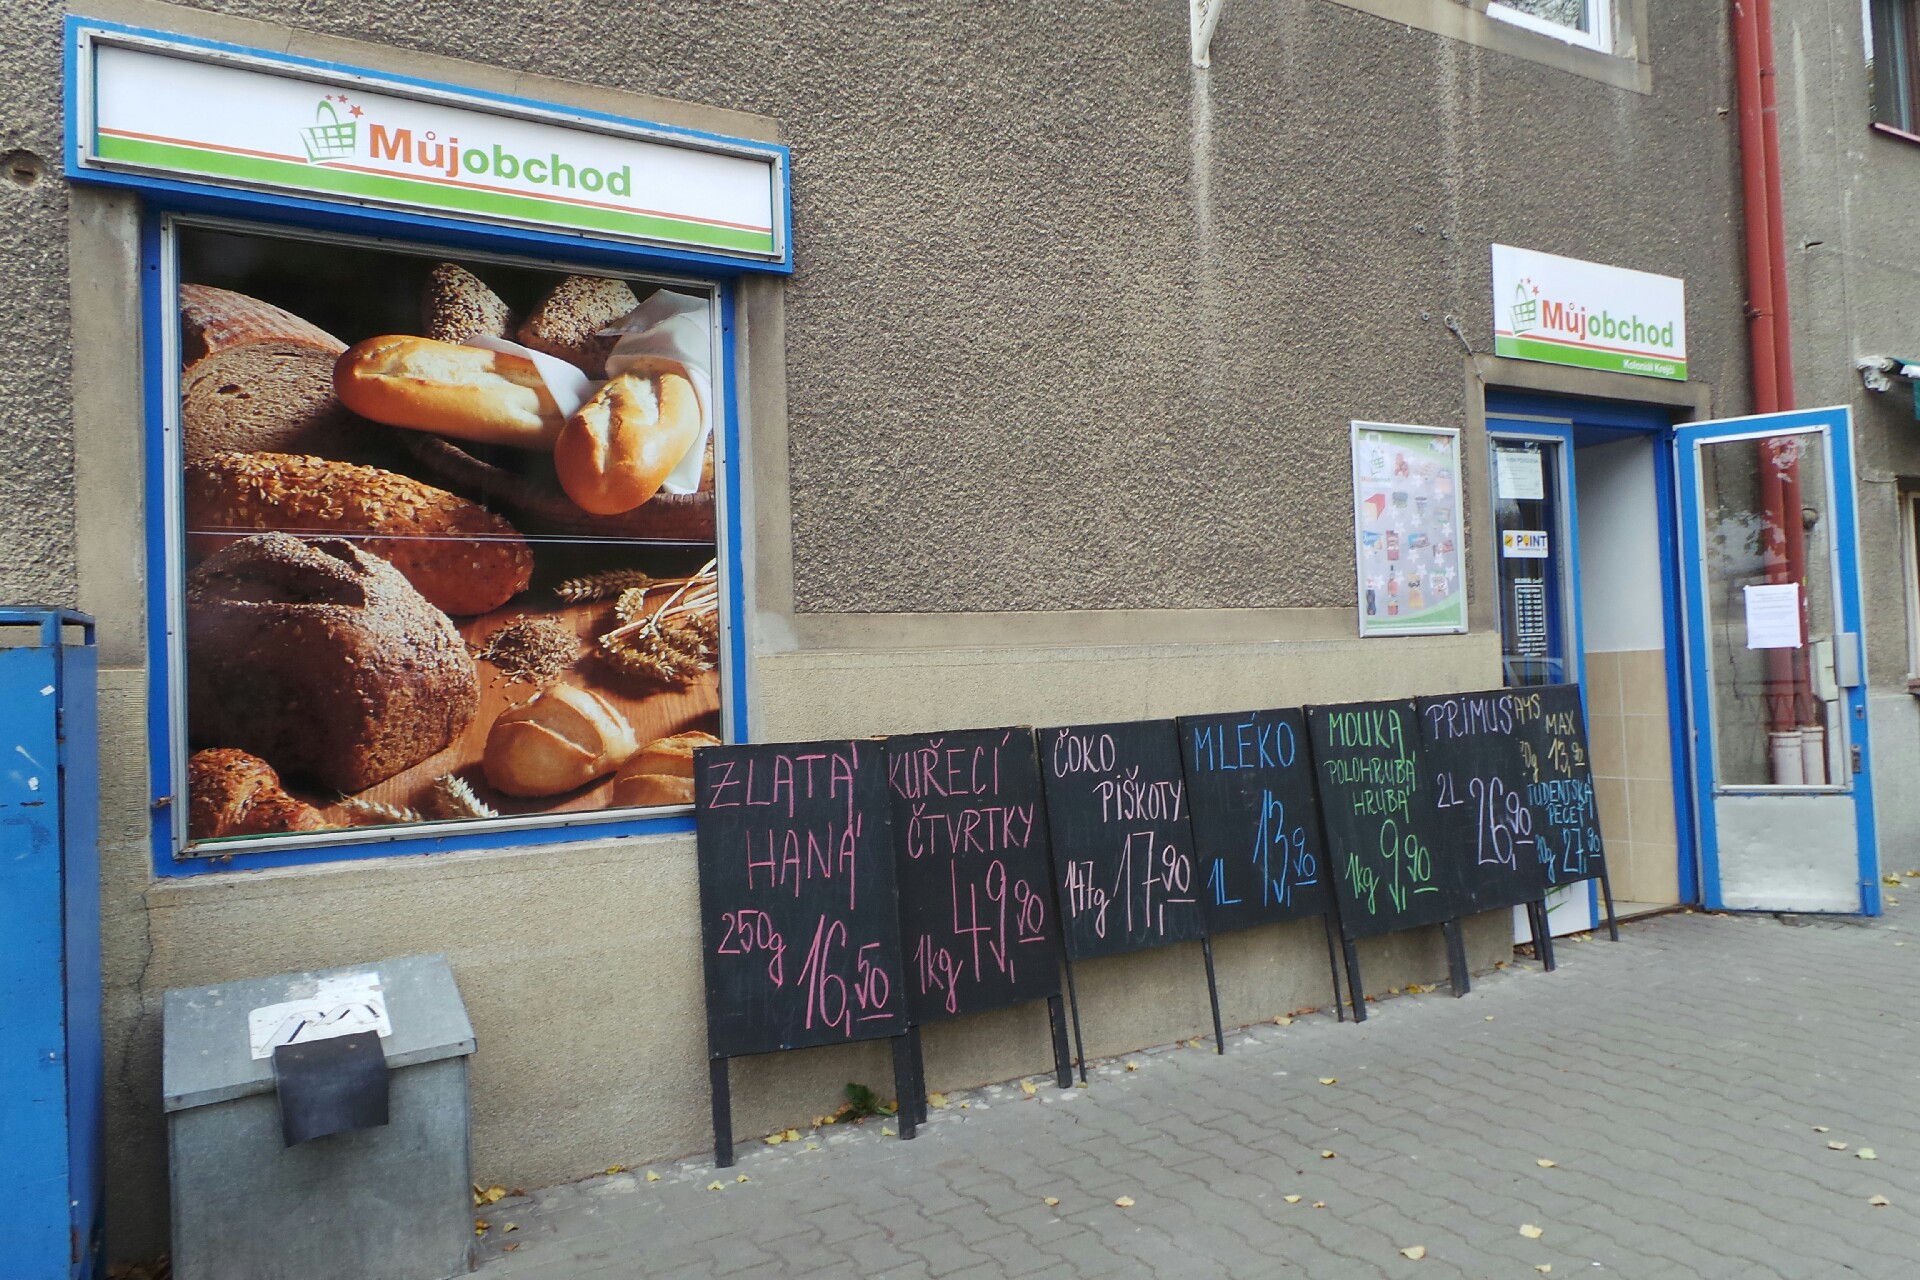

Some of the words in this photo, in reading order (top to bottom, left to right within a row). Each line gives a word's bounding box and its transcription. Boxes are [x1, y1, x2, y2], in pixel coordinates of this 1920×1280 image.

[369, 123, 631, 198] Můjobchod
[1542, 299, 1674, 348] Můjobchod
[1195, 712, 1296, 772] MLÉKO
[1329, 709, 1405, 760] MOUKA
[1425, 697, 1513, 739] PRIMUS
[1512, 693, 1540, 724] AYS
[1545, 710, 1576, 735] MAX
[888, 732, 1010, 799] KUŘECÍ
[1054, 728, 1116, 778] ČOKO
[708, 741, 858, 828] ZLATÁ
[1354, 784, 1411, 823] HRUBÁ
[1437, 773, 1464, 808] 2L
[1526, 773, 1593, 819] TUDENTSKÁ
[908, 803, 1034, 858] ČTVRTKY
[746, 813, 861, 910] HANÁ
[1345, 852, 1380, 915] 1kg
[1065, 861, 1110, 938] 147g
[718, 910, 786, 988] 250g
[914, 935, 963, 1014] 1kg
